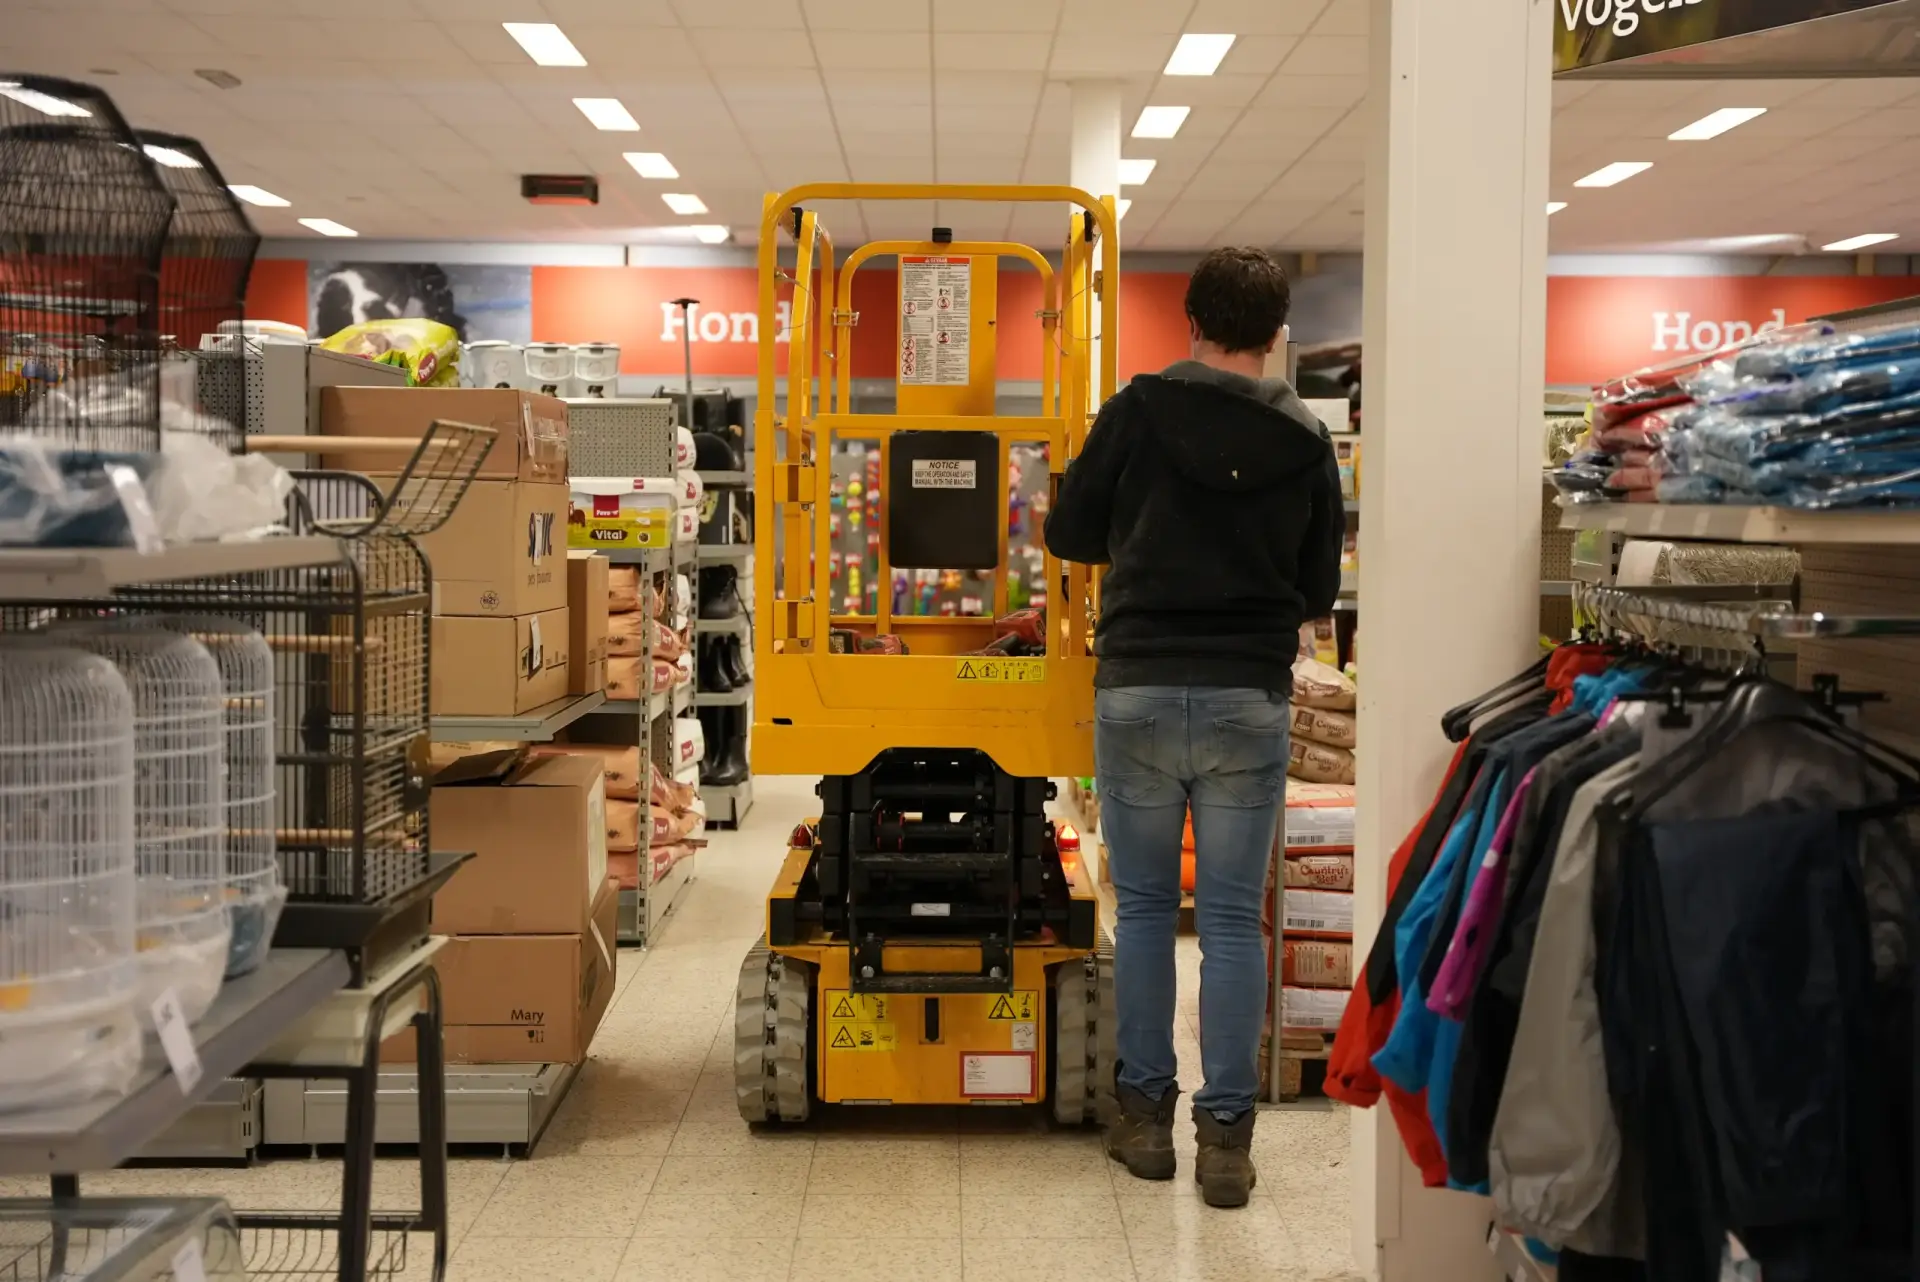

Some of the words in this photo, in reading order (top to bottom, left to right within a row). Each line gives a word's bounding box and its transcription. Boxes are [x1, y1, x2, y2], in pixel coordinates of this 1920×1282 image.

[928, 461, 960, 469] NOTICE
[595, 529, 623, 540] Vital
[510, 1009, 544, 1024] Mary
